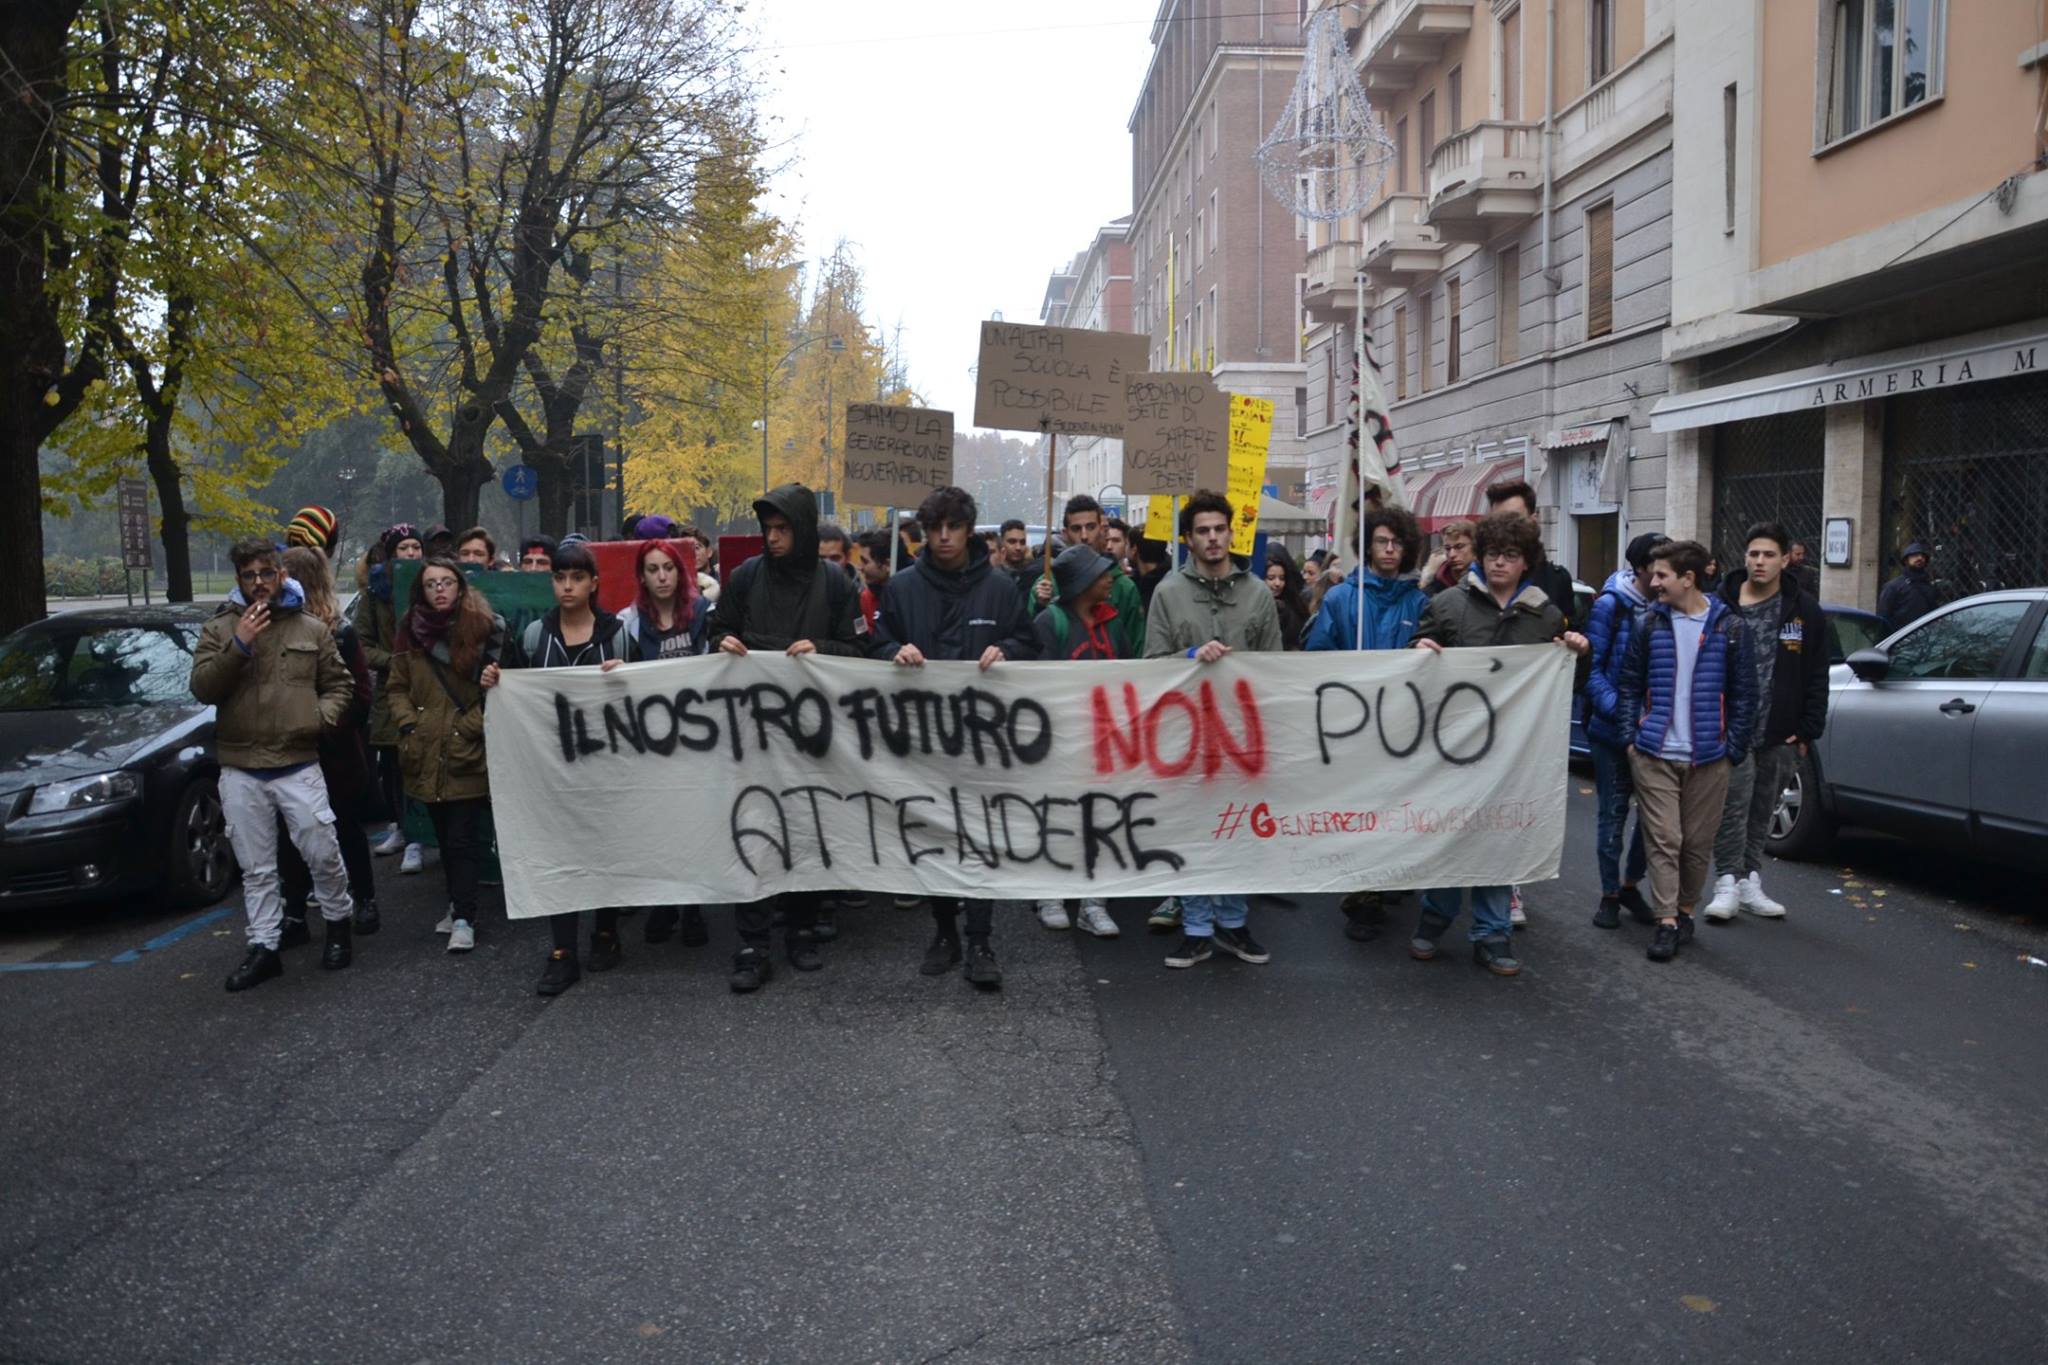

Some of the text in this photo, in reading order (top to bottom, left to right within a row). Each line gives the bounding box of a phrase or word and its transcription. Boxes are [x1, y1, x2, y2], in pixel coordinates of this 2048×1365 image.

[1012, 351, 1091, 380] SCUOLA
[1813, 348, 2036, 405] ARMERIA M
[990, 379, 1112, 415] POSSIBILE
[1127, 382, 1204, 404] ABBIAMO
[848, 404, 941, 440] SIAMO LA
[1128, 402, 1197, 423] SETE DI
[1152, 426, 1217, 452] SAPERE
[556, 693, 604, 762] IL
[604, 684, 832, 761] NOSTRO
[840, 687, 1051, 767] FUTURO
[1090, 677, 1269, 780] NON
[731, 785, 1186, 879] ATTENDERE
